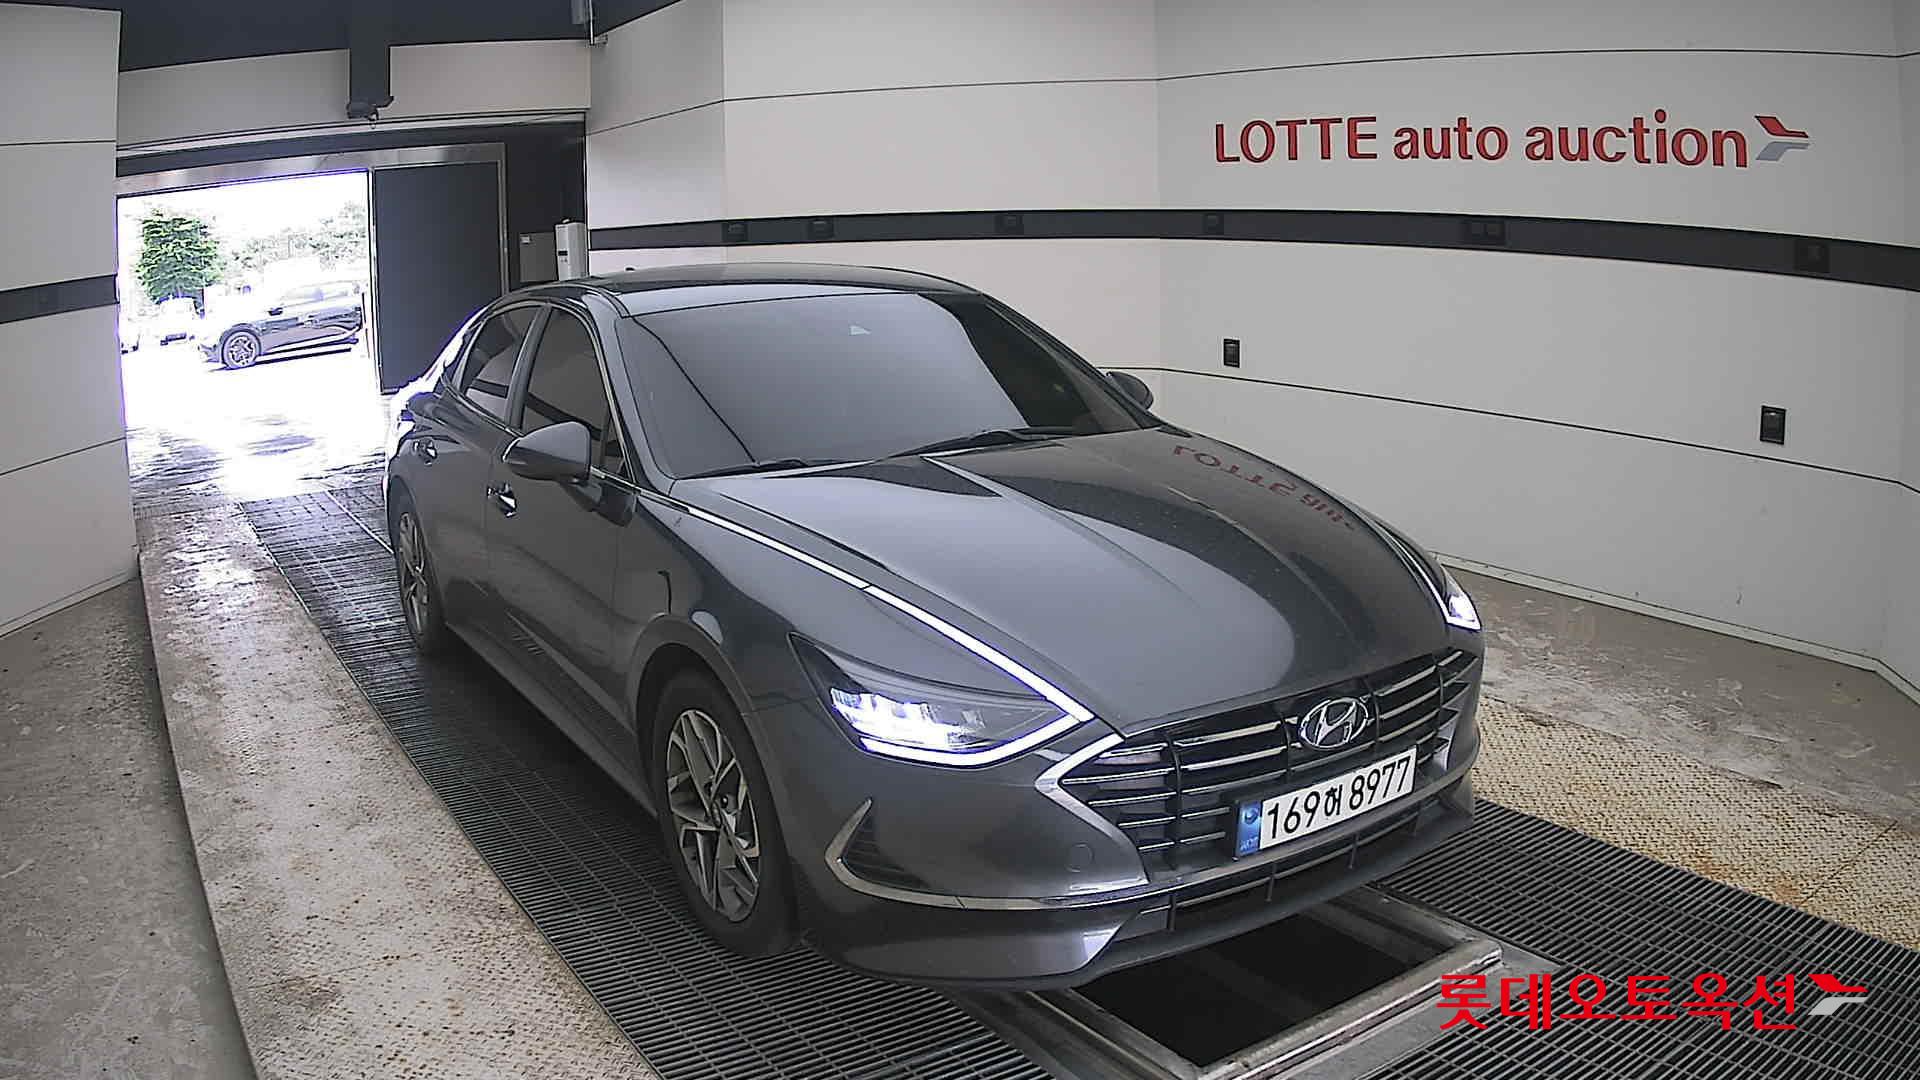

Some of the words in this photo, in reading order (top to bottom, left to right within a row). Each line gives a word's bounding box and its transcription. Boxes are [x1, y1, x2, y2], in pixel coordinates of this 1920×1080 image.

[1215, 116, 1377, 163] LOTTE
[1392, 117, 1509, 161] auto
[1524, 109, 1748, 168] auction
[1349, 758, 1410, 810] 8977
